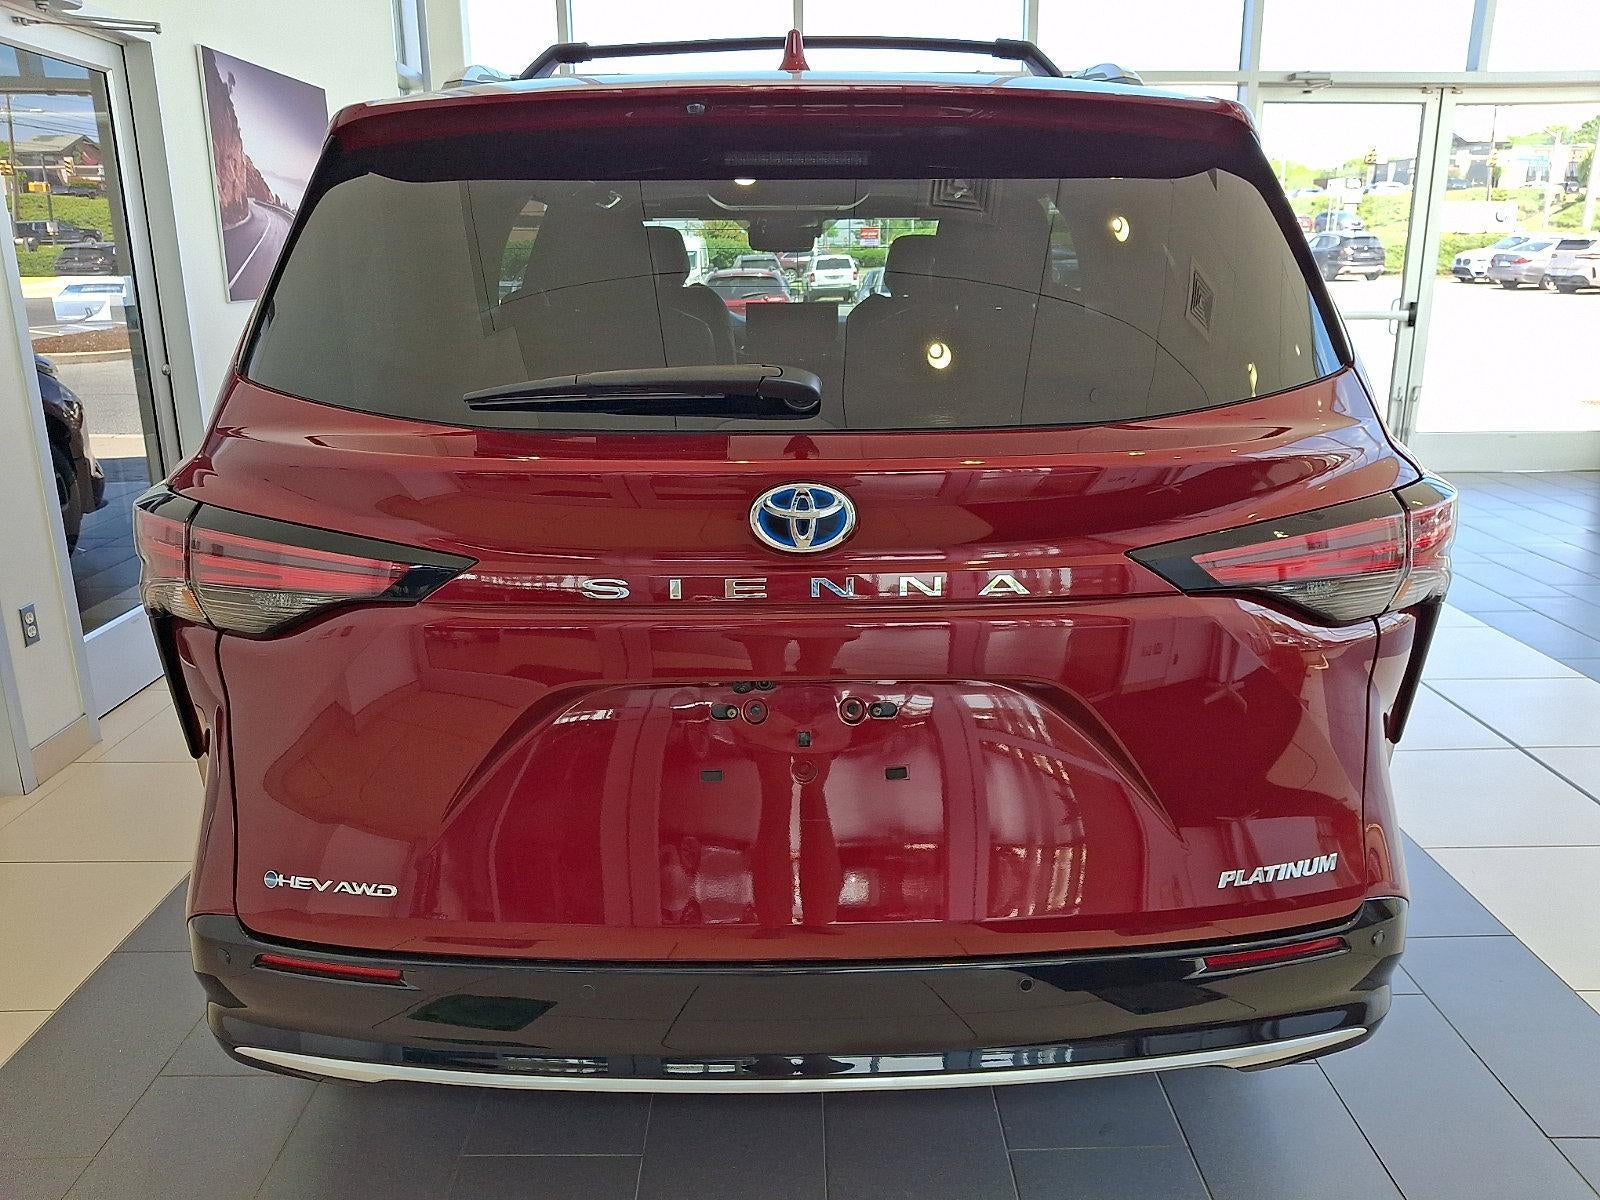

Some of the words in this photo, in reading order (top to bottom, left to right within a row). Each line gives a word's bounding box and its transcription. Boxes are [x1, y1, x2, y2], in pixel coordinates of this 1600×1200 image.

[582, 574, 1031, 599] SIENNA
[1217, 853, 1338, 889] PLATINUM
[278, 874, 334, 892] HEV
[333, 881, 398, 897] AWD
